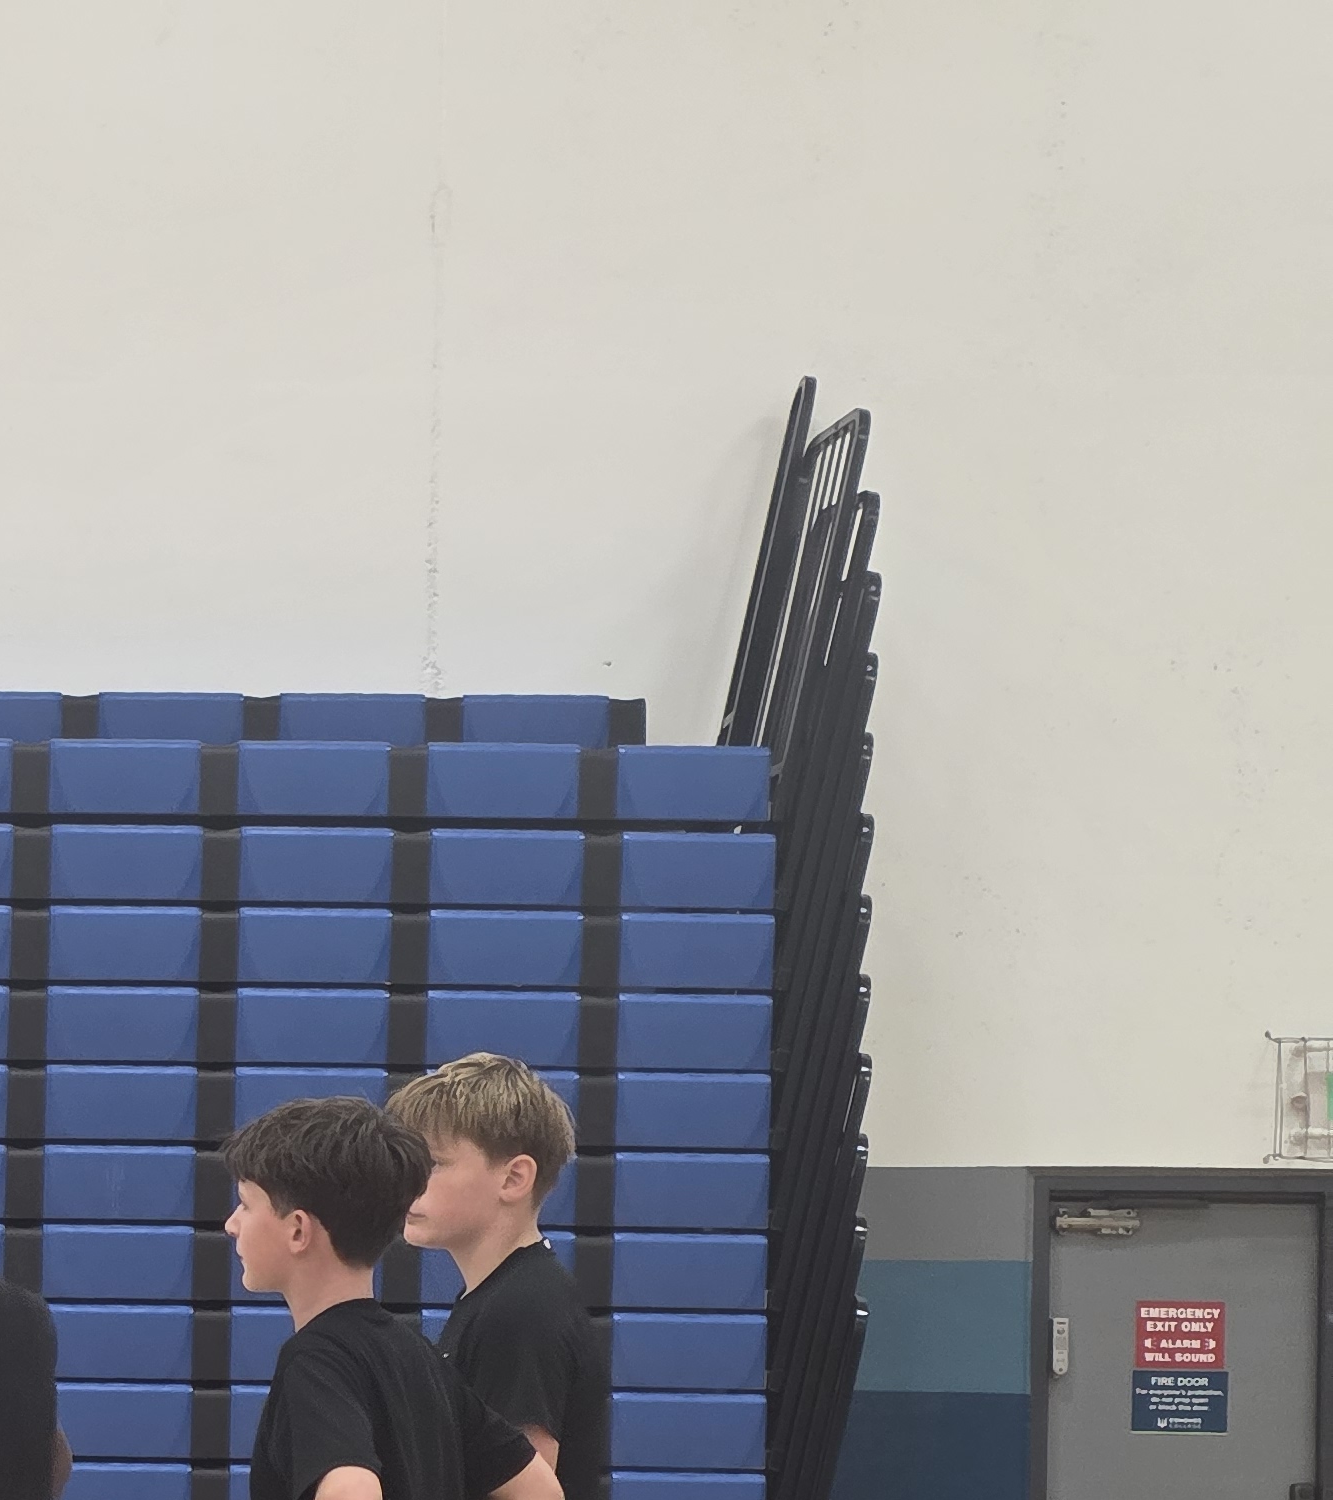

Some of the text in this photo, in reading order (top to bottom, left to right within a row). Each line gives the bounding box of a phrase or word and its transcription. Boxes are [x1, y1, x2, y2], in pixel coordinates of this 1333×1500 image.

[1140, 1307, 1221, 1319] EMERGENCY
[1146, 1321, 1214, 1333] EXIT ONLY
[1160, 1339, 1201, 1348] ALARM
[1144, 1352, 1216, 1363] WILL SOUND
[1151, 1376, 1209, 1387] FIRE DOOR
